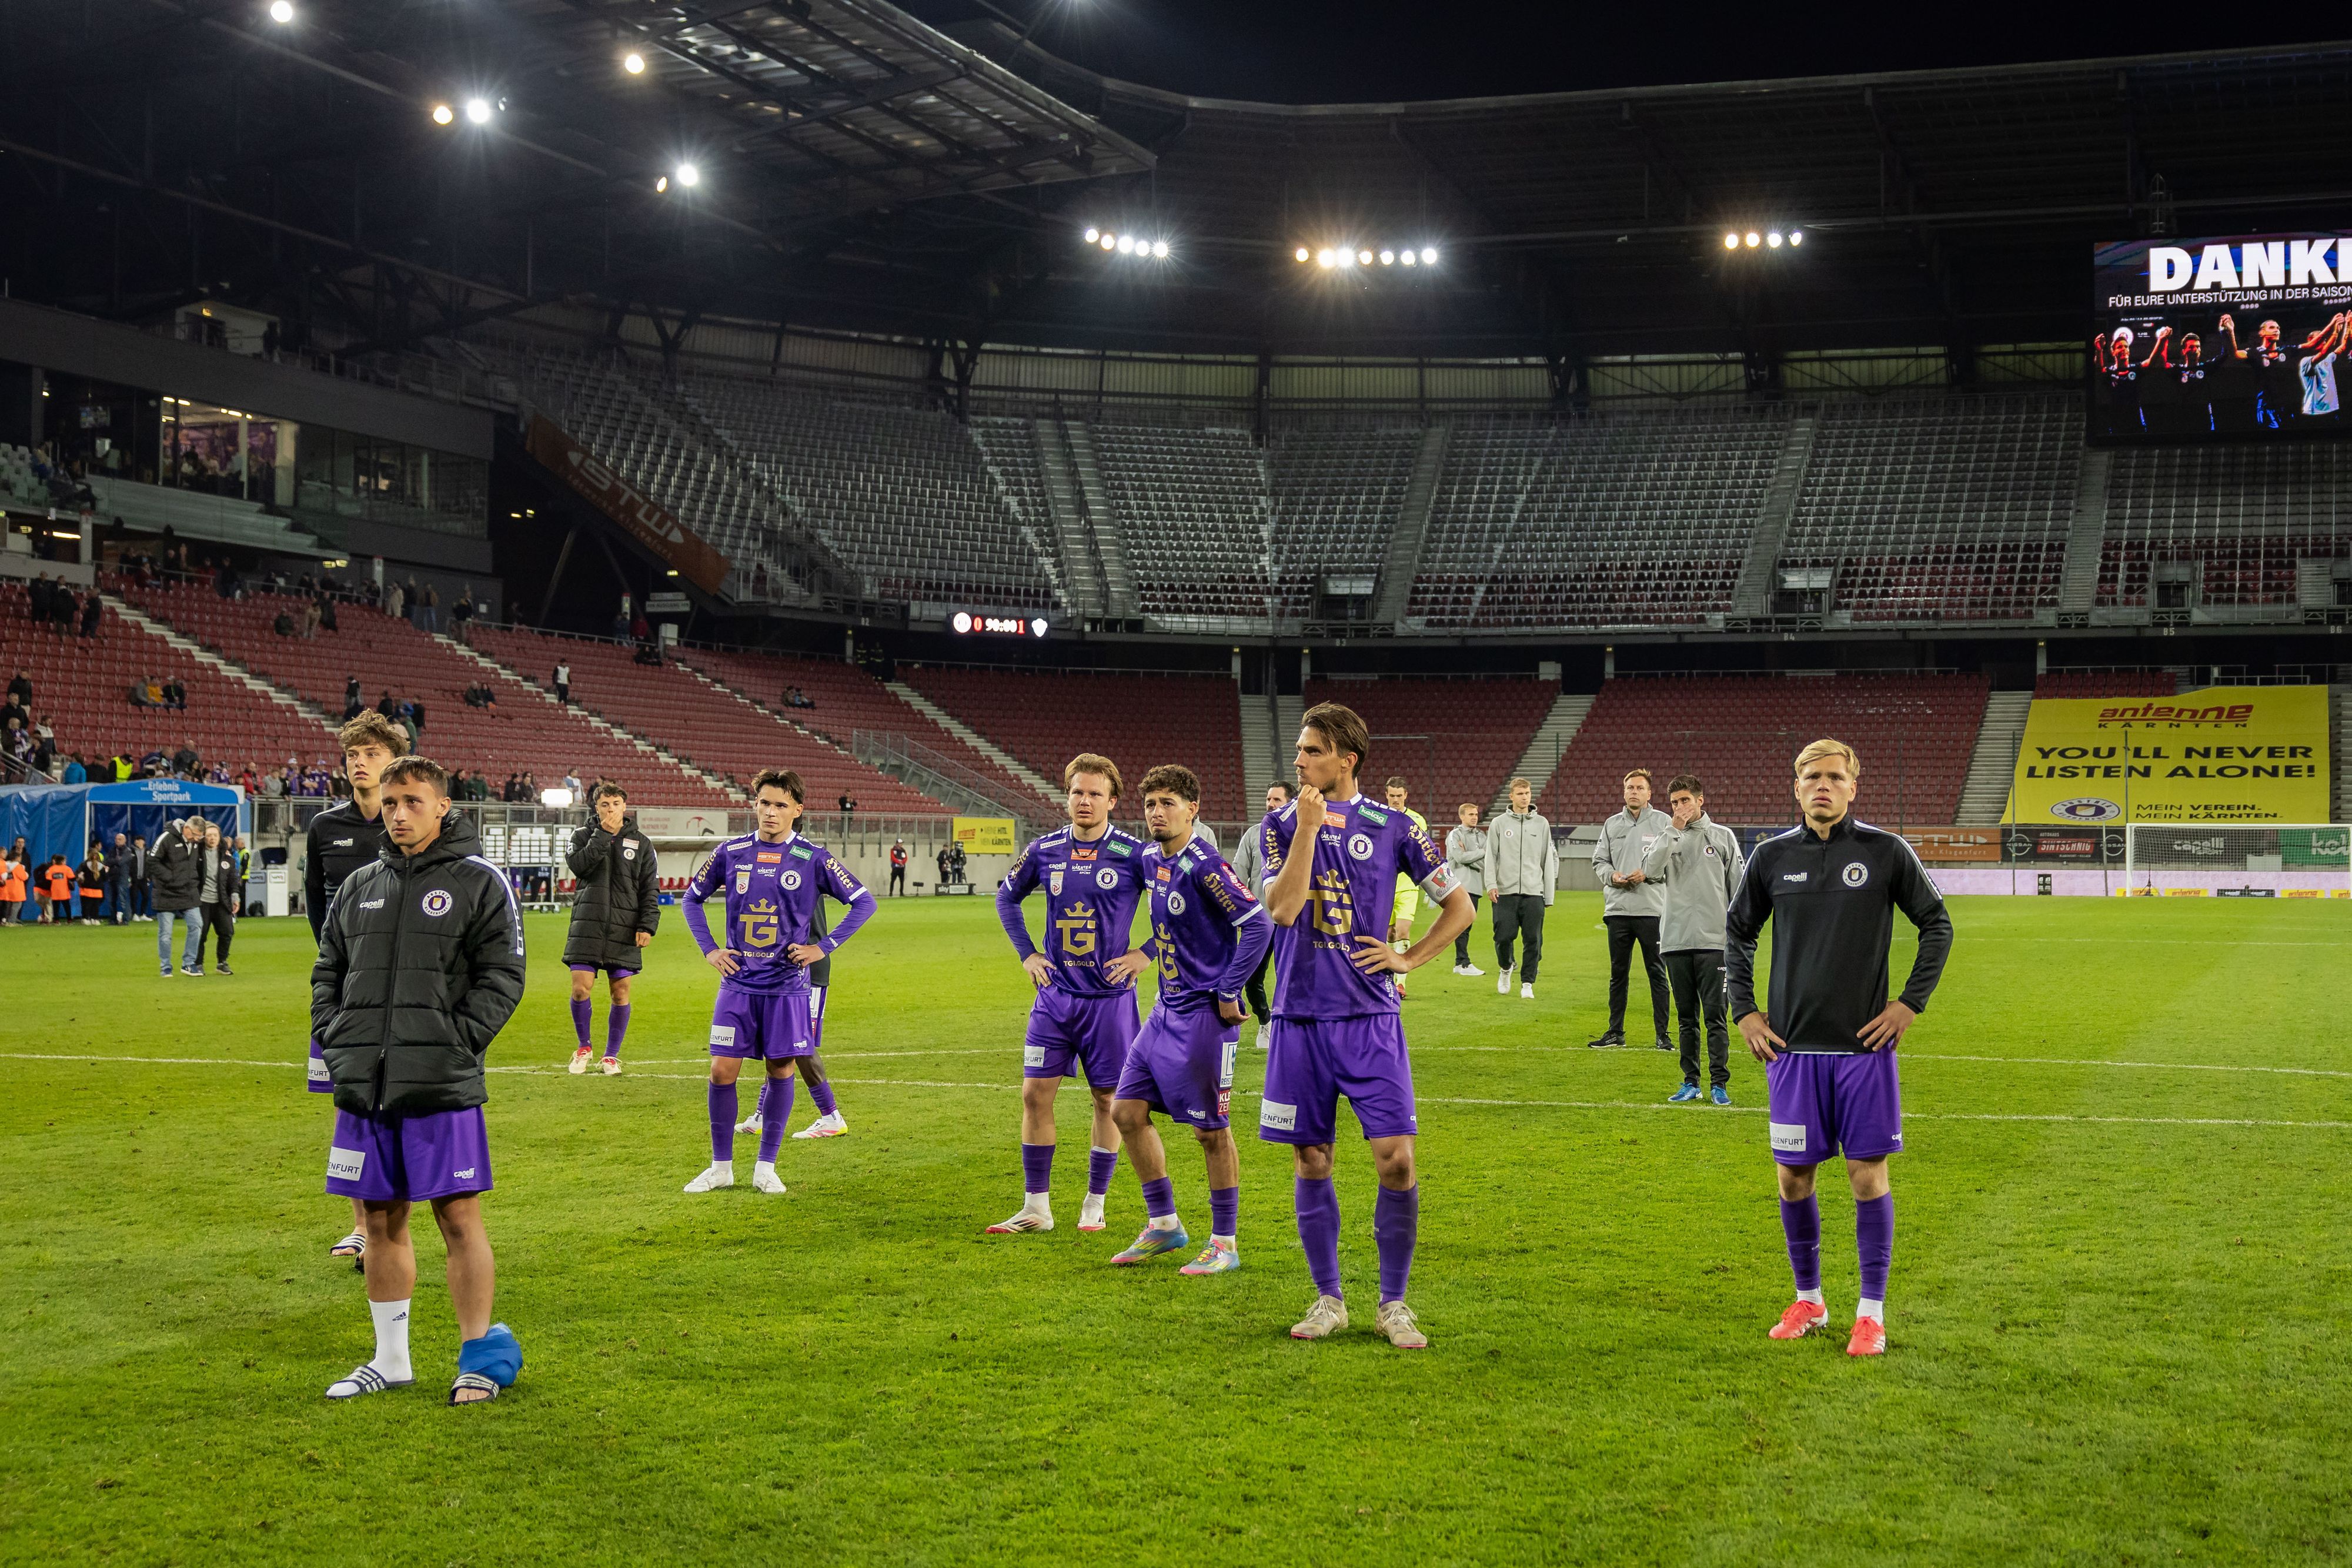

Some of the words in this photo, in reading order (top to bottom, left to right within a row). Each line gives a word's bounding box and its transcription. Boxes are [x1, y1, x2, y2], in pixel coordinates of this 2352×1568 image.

[2109, 295, 2132, 307] FÜR
[2134, 294, 2164, 306] EURE
[2167, 289, 2268, 305] UNTERSTÜTZUNG
[2270, 289, 2283, 300] IN
[2285, 288, 2310, 300] DER
[2099, 703, 2254, 722] antenne
[2184, 745, 2313, 759] NEVER
[2026, 765, 2151, 778] LISTEN
[2165, 765, 2316, 778] ALONE!
[152, 791, 191, 803] Sportpark
[1361, 807, 1385, 823] kelag
[1110, 842, 1130, 855] kelag
[1408, 824, 1441, 867] Hirter
[792, 847, 810, 859] kelag
[825, 857, 854, 889] Hirter
[1783, 872, 1808, 881] capelli
[1204, 872, 1237, 912] Hirter
[359, 898, 385, 908] capelli
[1187, 1109, 1205, 1118] capelli
[453, 1168, 475, 1178] capelli
